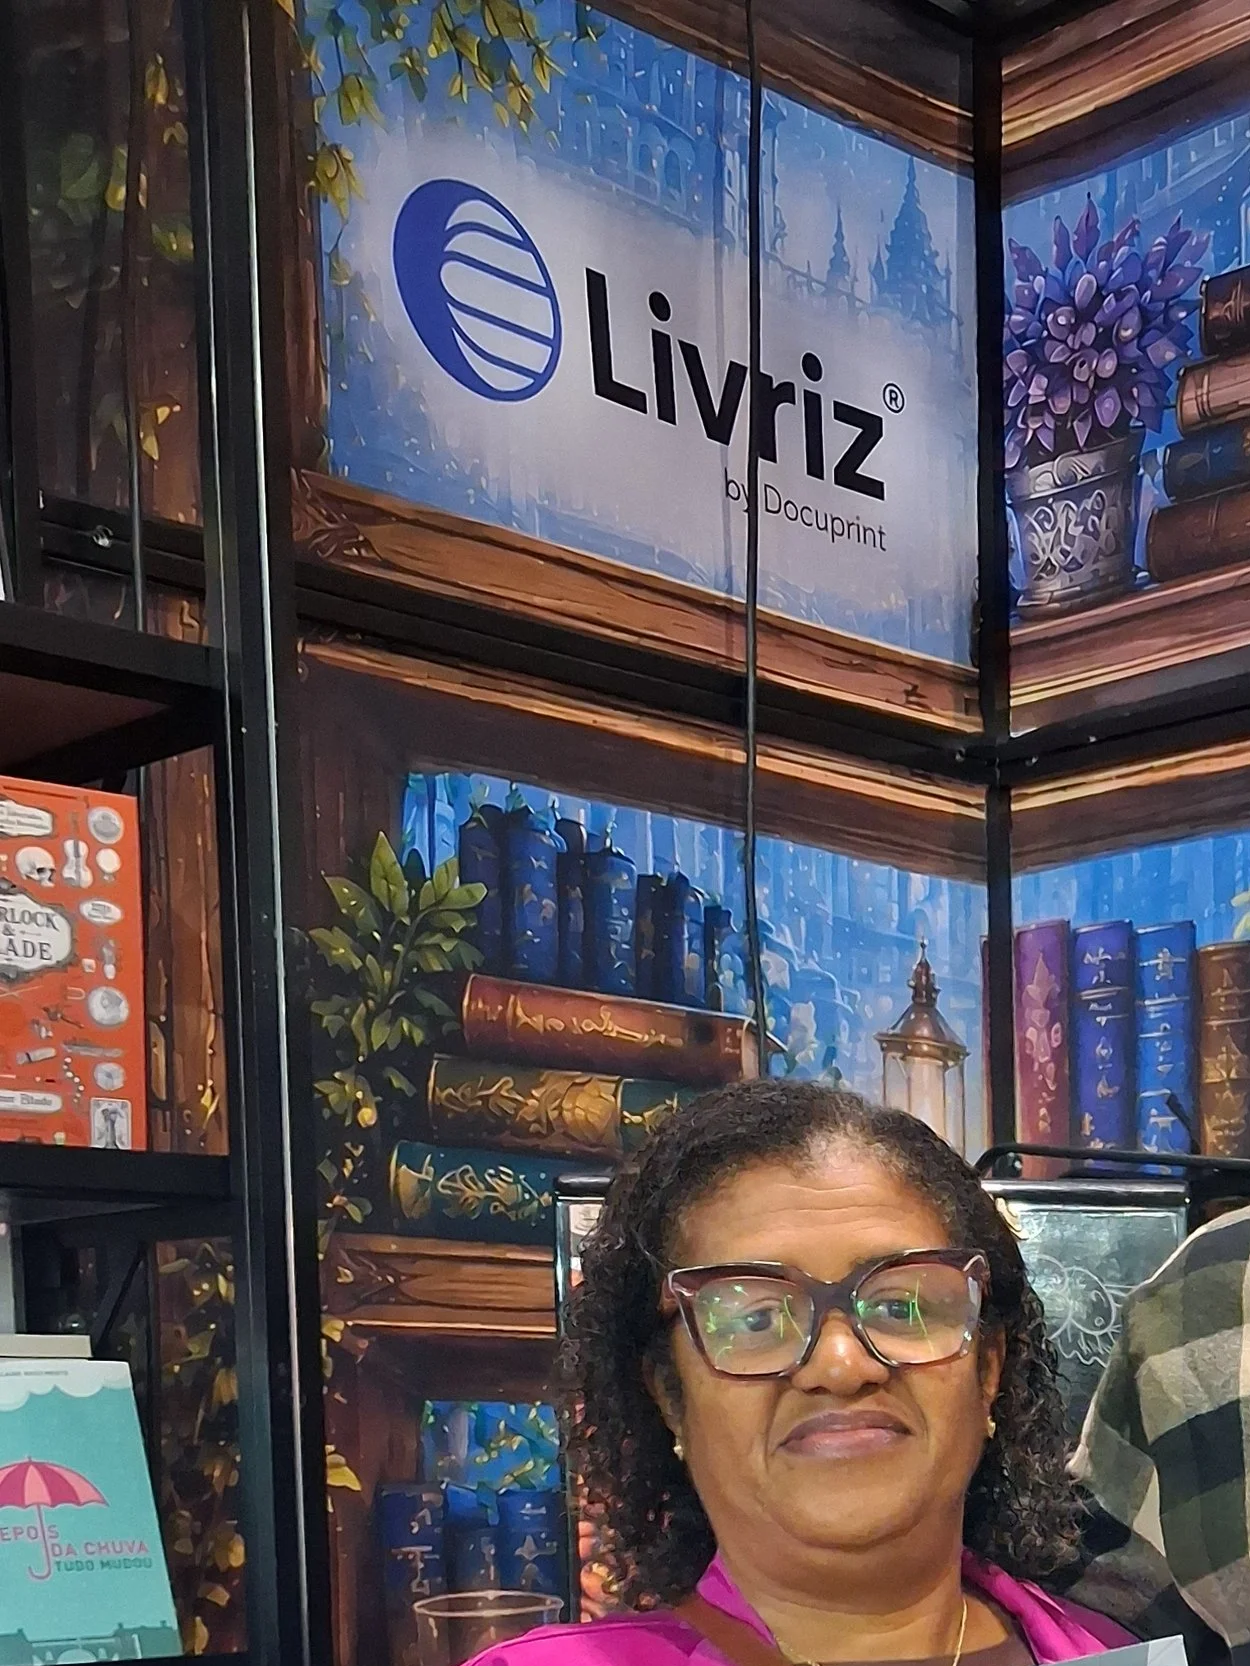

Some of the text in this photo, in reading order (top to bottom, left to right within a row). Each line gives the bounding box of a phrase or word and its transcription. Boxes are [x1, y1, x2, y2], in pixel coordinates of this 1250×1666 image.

[764, 484, 887, 551] Docuprint
[51, 1540, 149, 1558] DA CHUVA
[54, 1560, 95, 1573] TUDO
